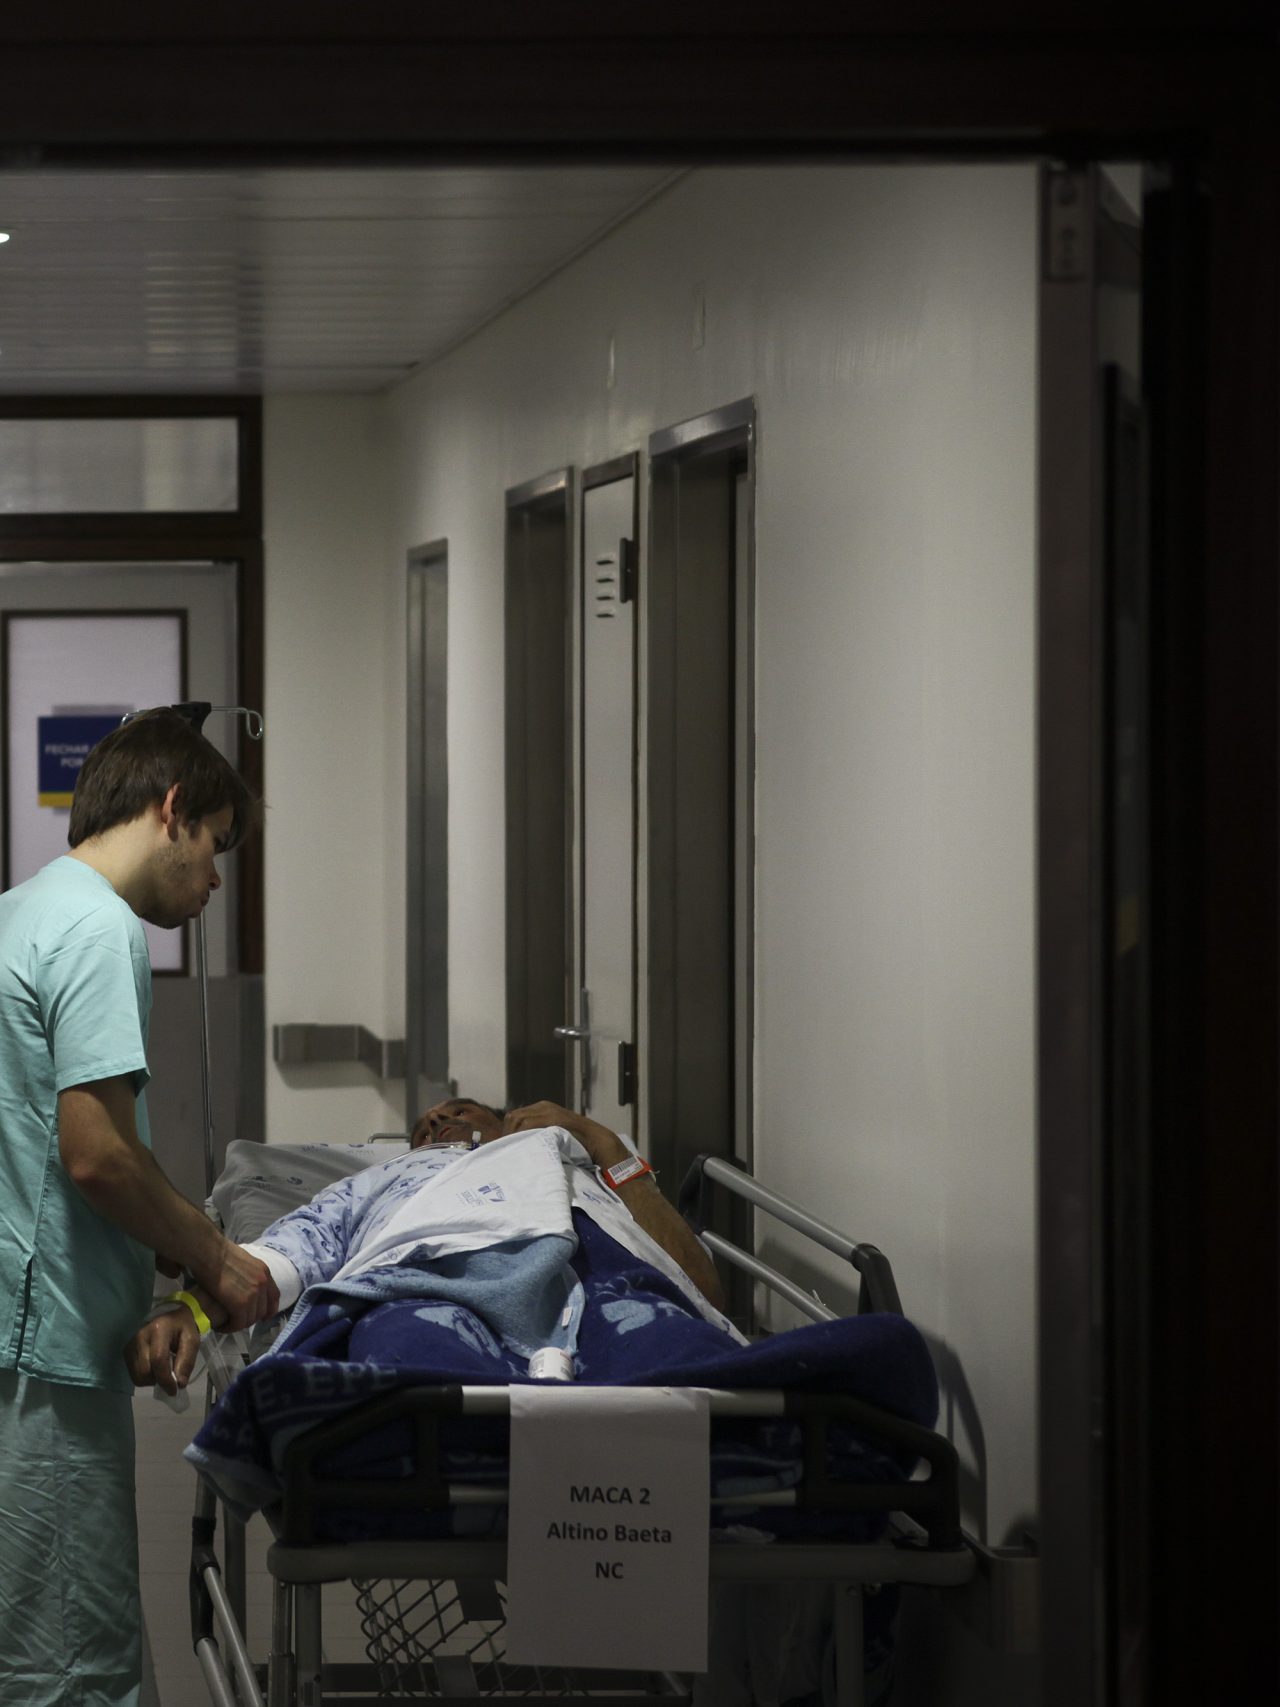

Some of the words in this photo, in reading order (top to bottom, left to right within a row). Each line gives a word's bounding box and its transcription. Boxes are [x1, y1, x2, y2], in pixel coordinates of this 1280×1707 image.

[45, 743, 89, 754] FECHAR
[569, 1485, 634, 1505] MACA
[639, 1487, 651, 1506] 2
[546, 1521, 609, 1542] Altino
[614, 1524, 672, 1544] Baeta
[595, 1561, 624, 1580] NC
